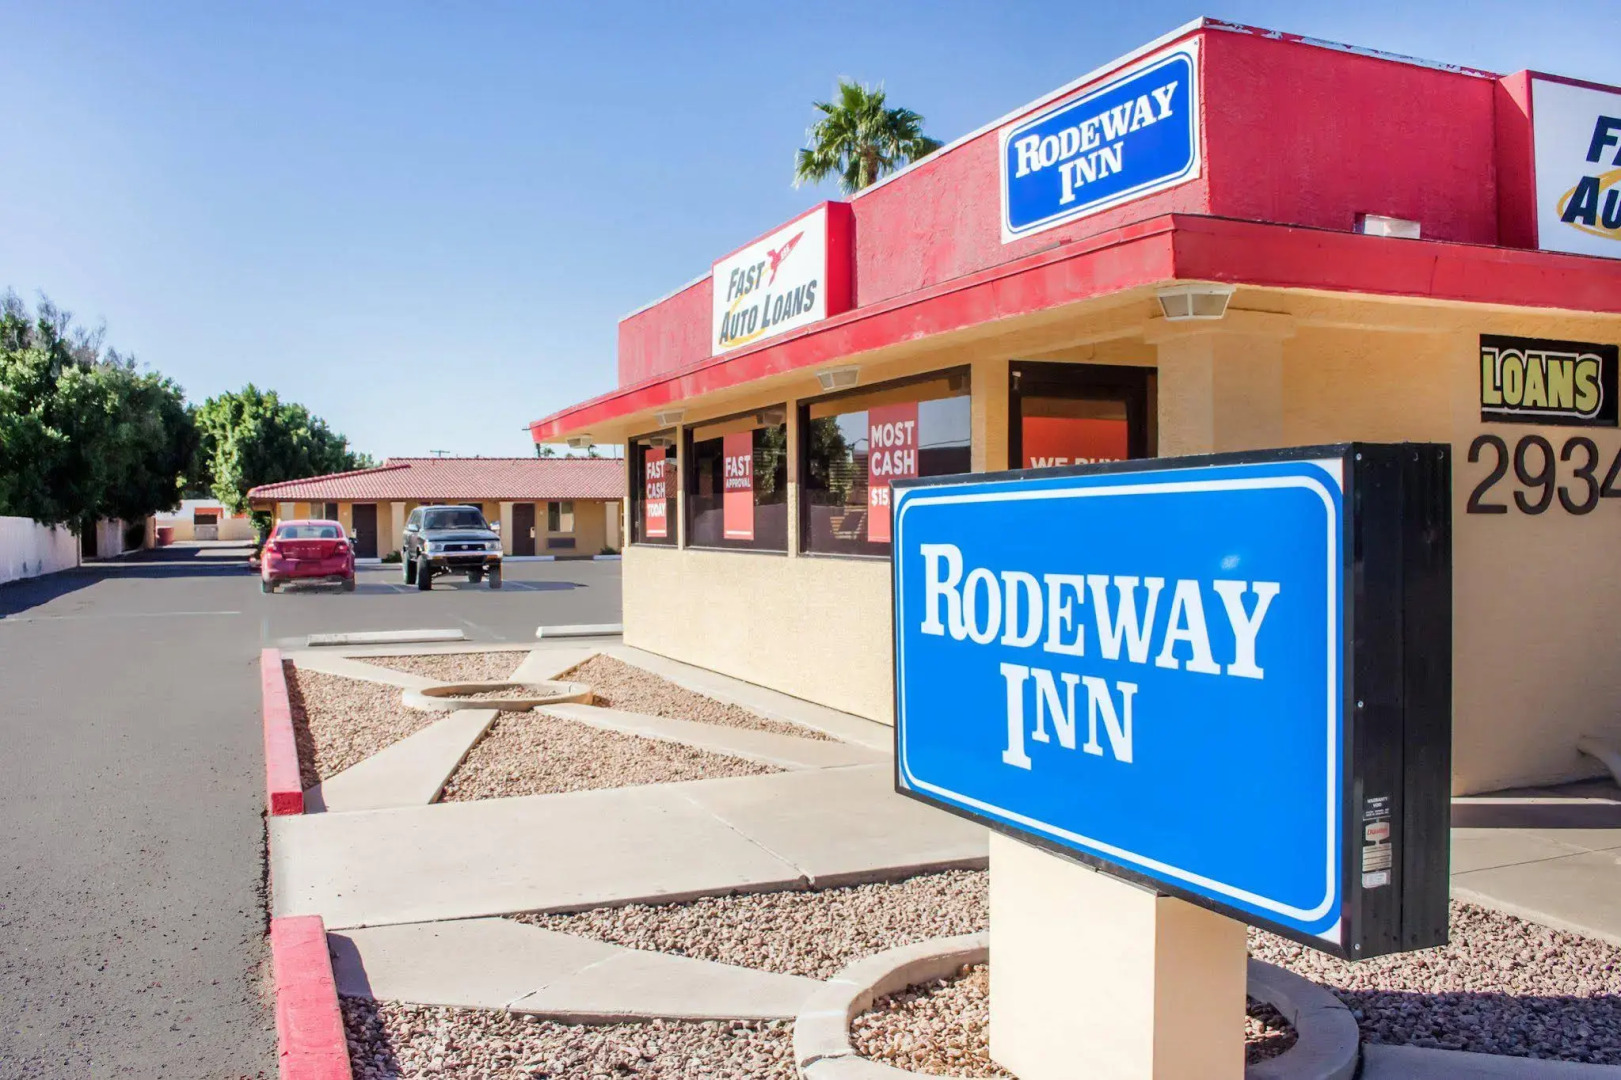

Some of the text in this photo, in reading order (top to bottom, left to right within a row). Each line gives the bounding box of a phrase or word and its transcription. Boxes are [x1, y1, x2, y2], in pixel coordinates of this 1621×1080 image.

[1014, 80, 1179, 179] RODEWAY
[1586, 115, 1621, 166] F
[1058, 141, 1125, 205] INN
[726, 260, 766, 302] FAST
[718, 279, 817, 345] AUTO LOANS
[1482, 354, 1599, 412] LOANS
[871, 420, 915, 449] MOST
[647, 460, 665, 479] FAST
[725, 455, 751, 476] FAST
[726, 478, 751, 488] APPROVAL
[871, 449, 915, 476] CASH
[647, 482, 665, 499] CASH
[648, 503, 666, 517] TODAY
[920, 543, 1280, 679] RODEWAY
[1000, 662, 1138, 770] INN
